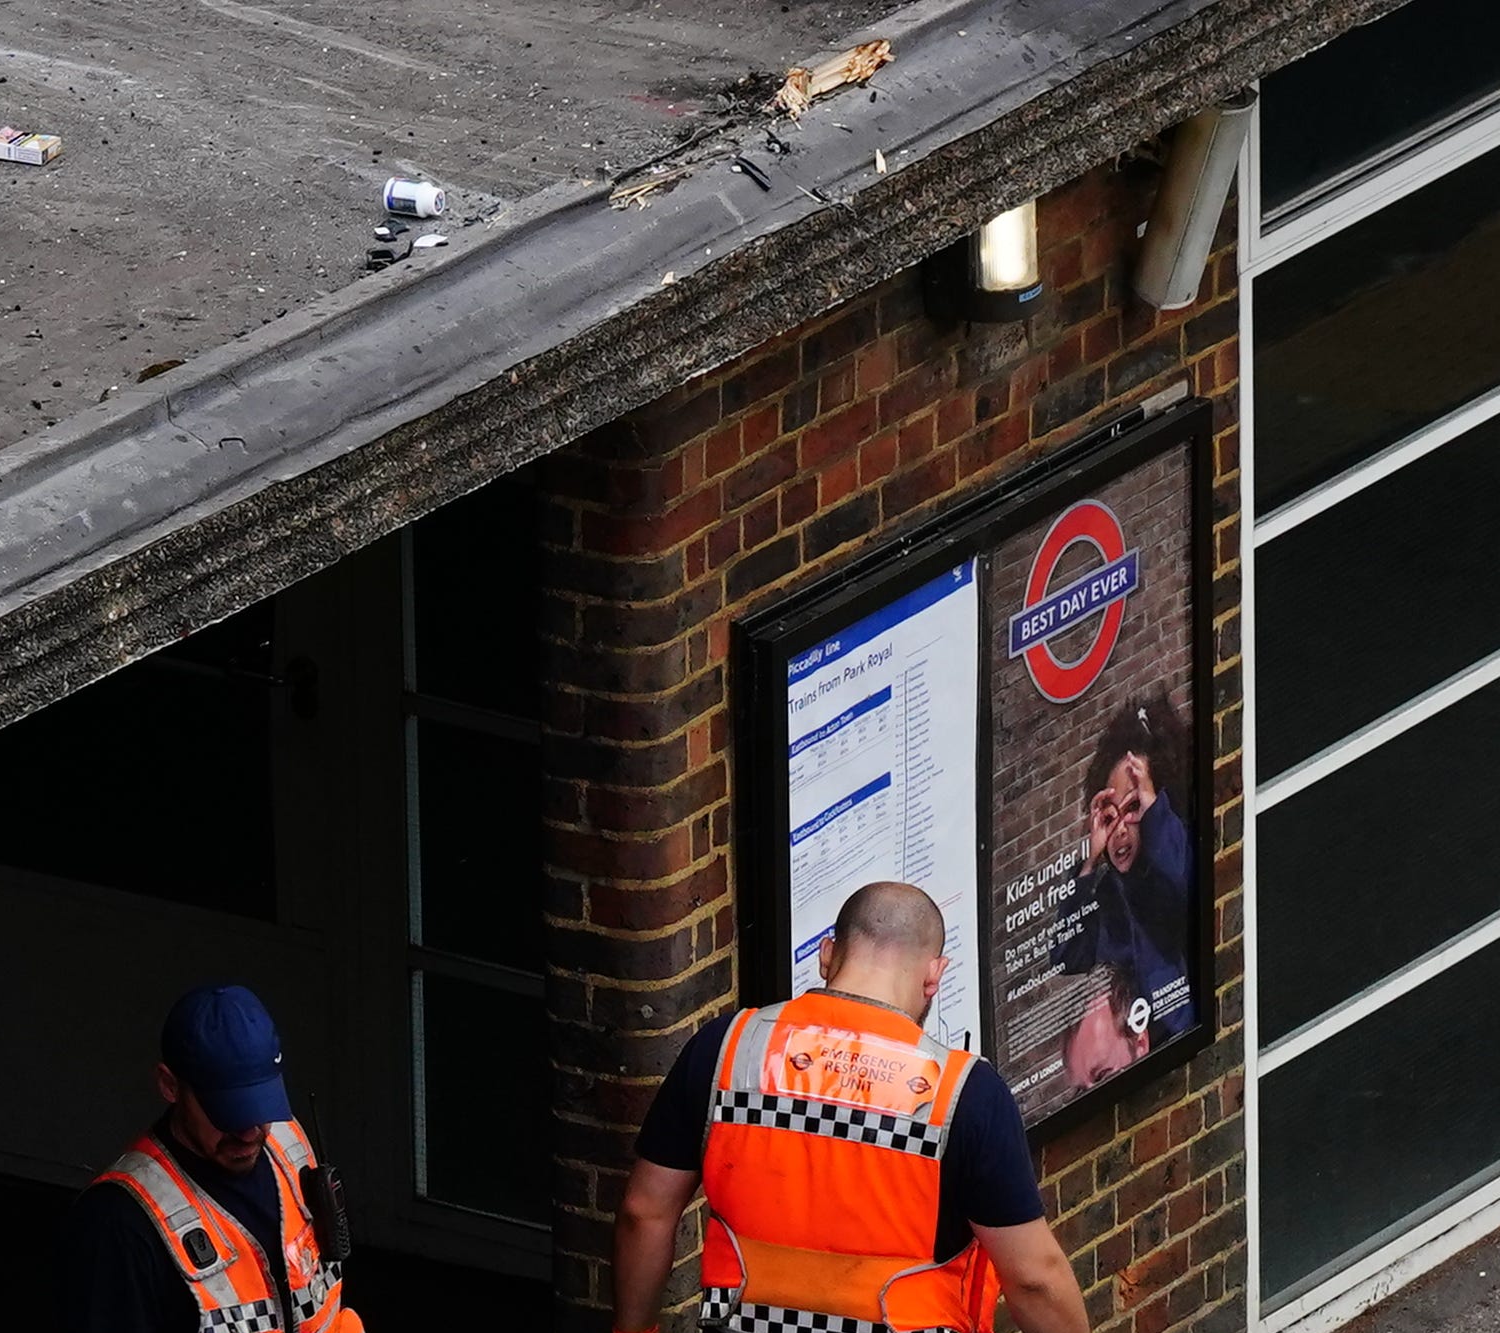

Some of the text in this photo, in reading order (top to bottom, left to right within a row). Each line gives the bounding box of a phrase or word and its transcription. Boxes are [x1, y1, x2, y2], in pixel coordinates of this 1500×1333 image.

[1021, 566, 1127, 641] BEST DAY EVER
[788, 646, 823, 678] Piccadilly
[788, 642, 893, 714] Trains from Park Royal
[1006, 875, 1035, 906] Kids
[1037, 849, 1078, 884] under
[1005, 878, 1077, 933] travel free
[1005, 900, 1100, 962] Do more of what you love.
[1005, 956, 1024, 975] Tube
[1033, 944, 1047, 960] Bus
[1056, 928, 1076, 947] Train
[1006, 961, 1066, 1002] #LetsDoLondon
[1152, 976, 1187, 1000] TRANSPORT
[1152, 999, 1164, 1012] FOR
[1164, 985, 1190, 1007] LONDON
[820, 1047, 907, 1073] EMERGENCY
[824, 1060, 896, 1084] RESPONSE
[1010, 1058, 1064, 1096] MAYOR OF LONDON
[840, 1076, 874, 1092] UNIT
